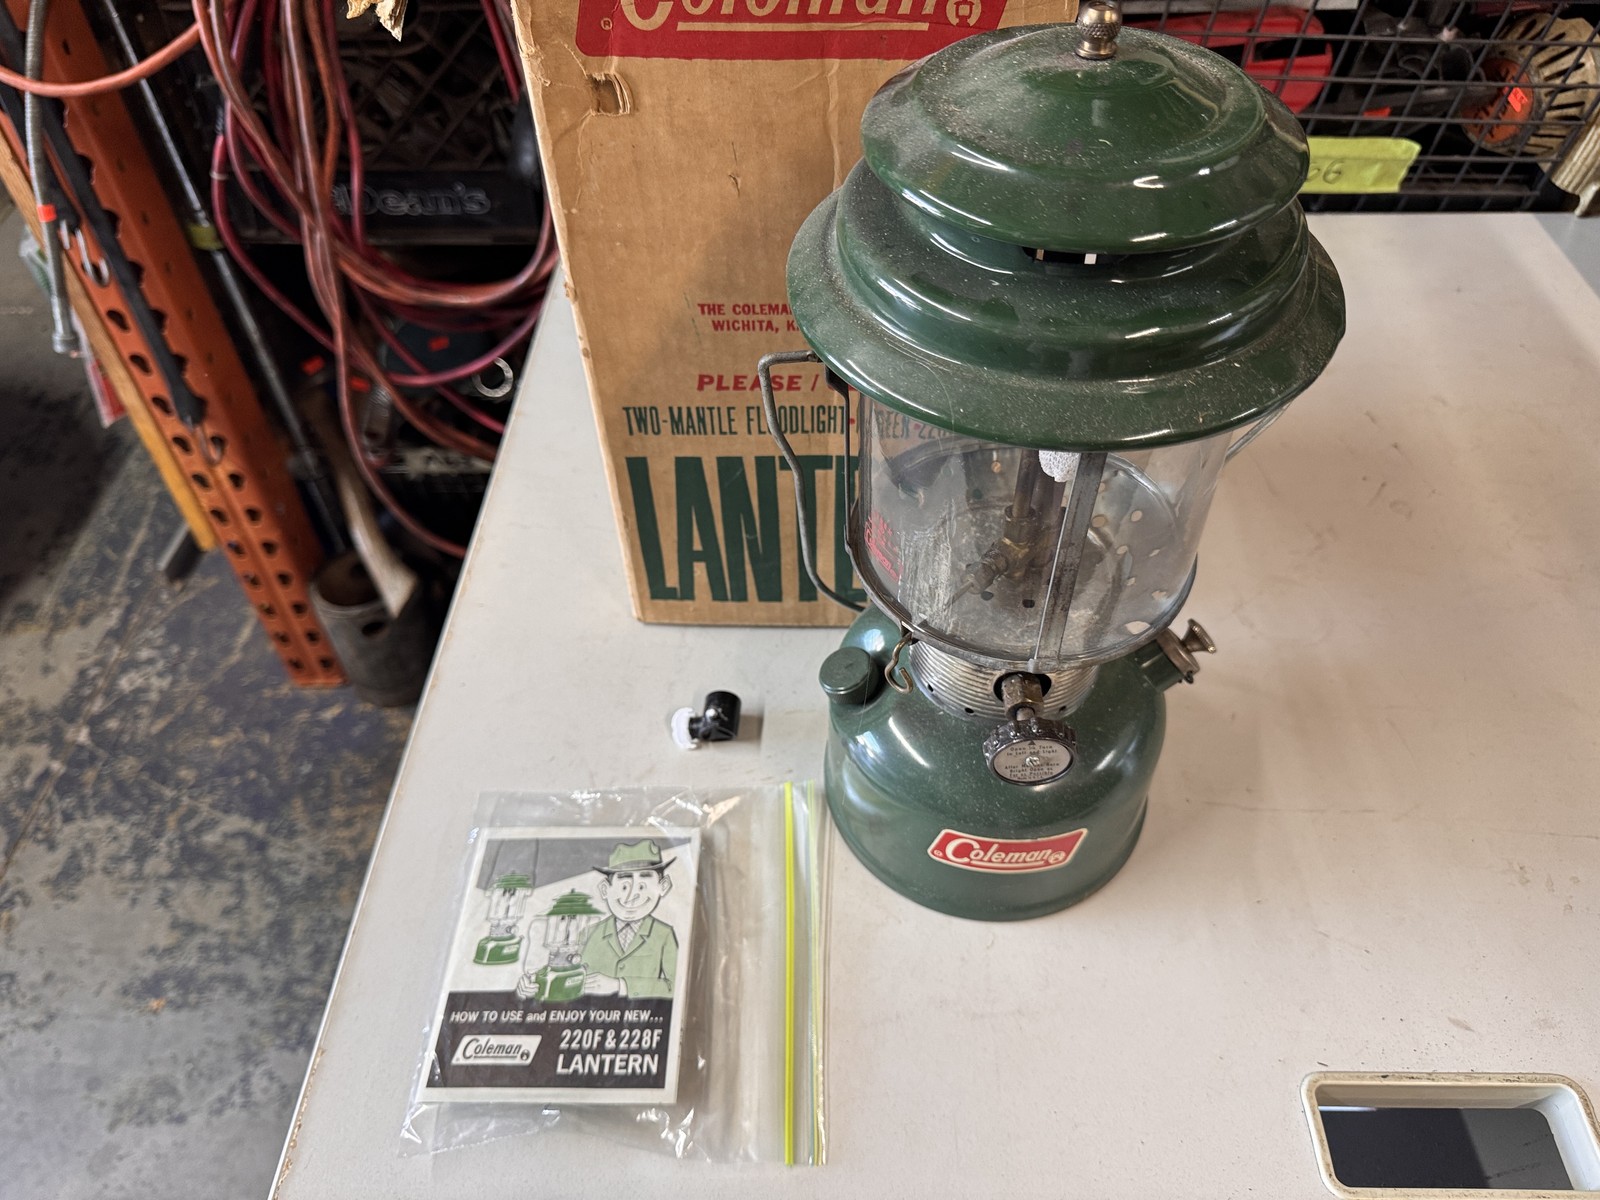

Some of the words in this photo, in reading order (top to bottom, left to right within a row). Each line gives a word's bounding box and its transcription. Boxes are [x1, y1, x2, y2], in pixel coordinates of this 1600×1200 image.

[697, 303, 726, 316] THE
[732, 303, 792, 316] COLEMA
[712, 320, 779, 334] WICHITA,
[786, 320, 800, 331] K
[622, 405, 739, 436] TWO-MANTLE
[746, 405, 846, 435] FLODLIGHT
[945, 838, 1052, 864] Coleman
[450, 1010, 480, 1023] HOW
[482, 1010, 499, 1023] TO
[501, 1010, 524, 1022] USE
[525, 1010, 547, 1022] and
[549, 1009, 587, 1023] ENJOY
[589, 1009, 621, 1022] YOUR
[623, 1009, 664, 1022] NEW...
[462, 1037, 523, 1060] Coleman
[559, 1028, 604, 1050] 220F
[605, 1028, 616, 1050] &
[618, 1028, 662, 1050] 228F
[556, 1053, 660, 1076] LANTERN
